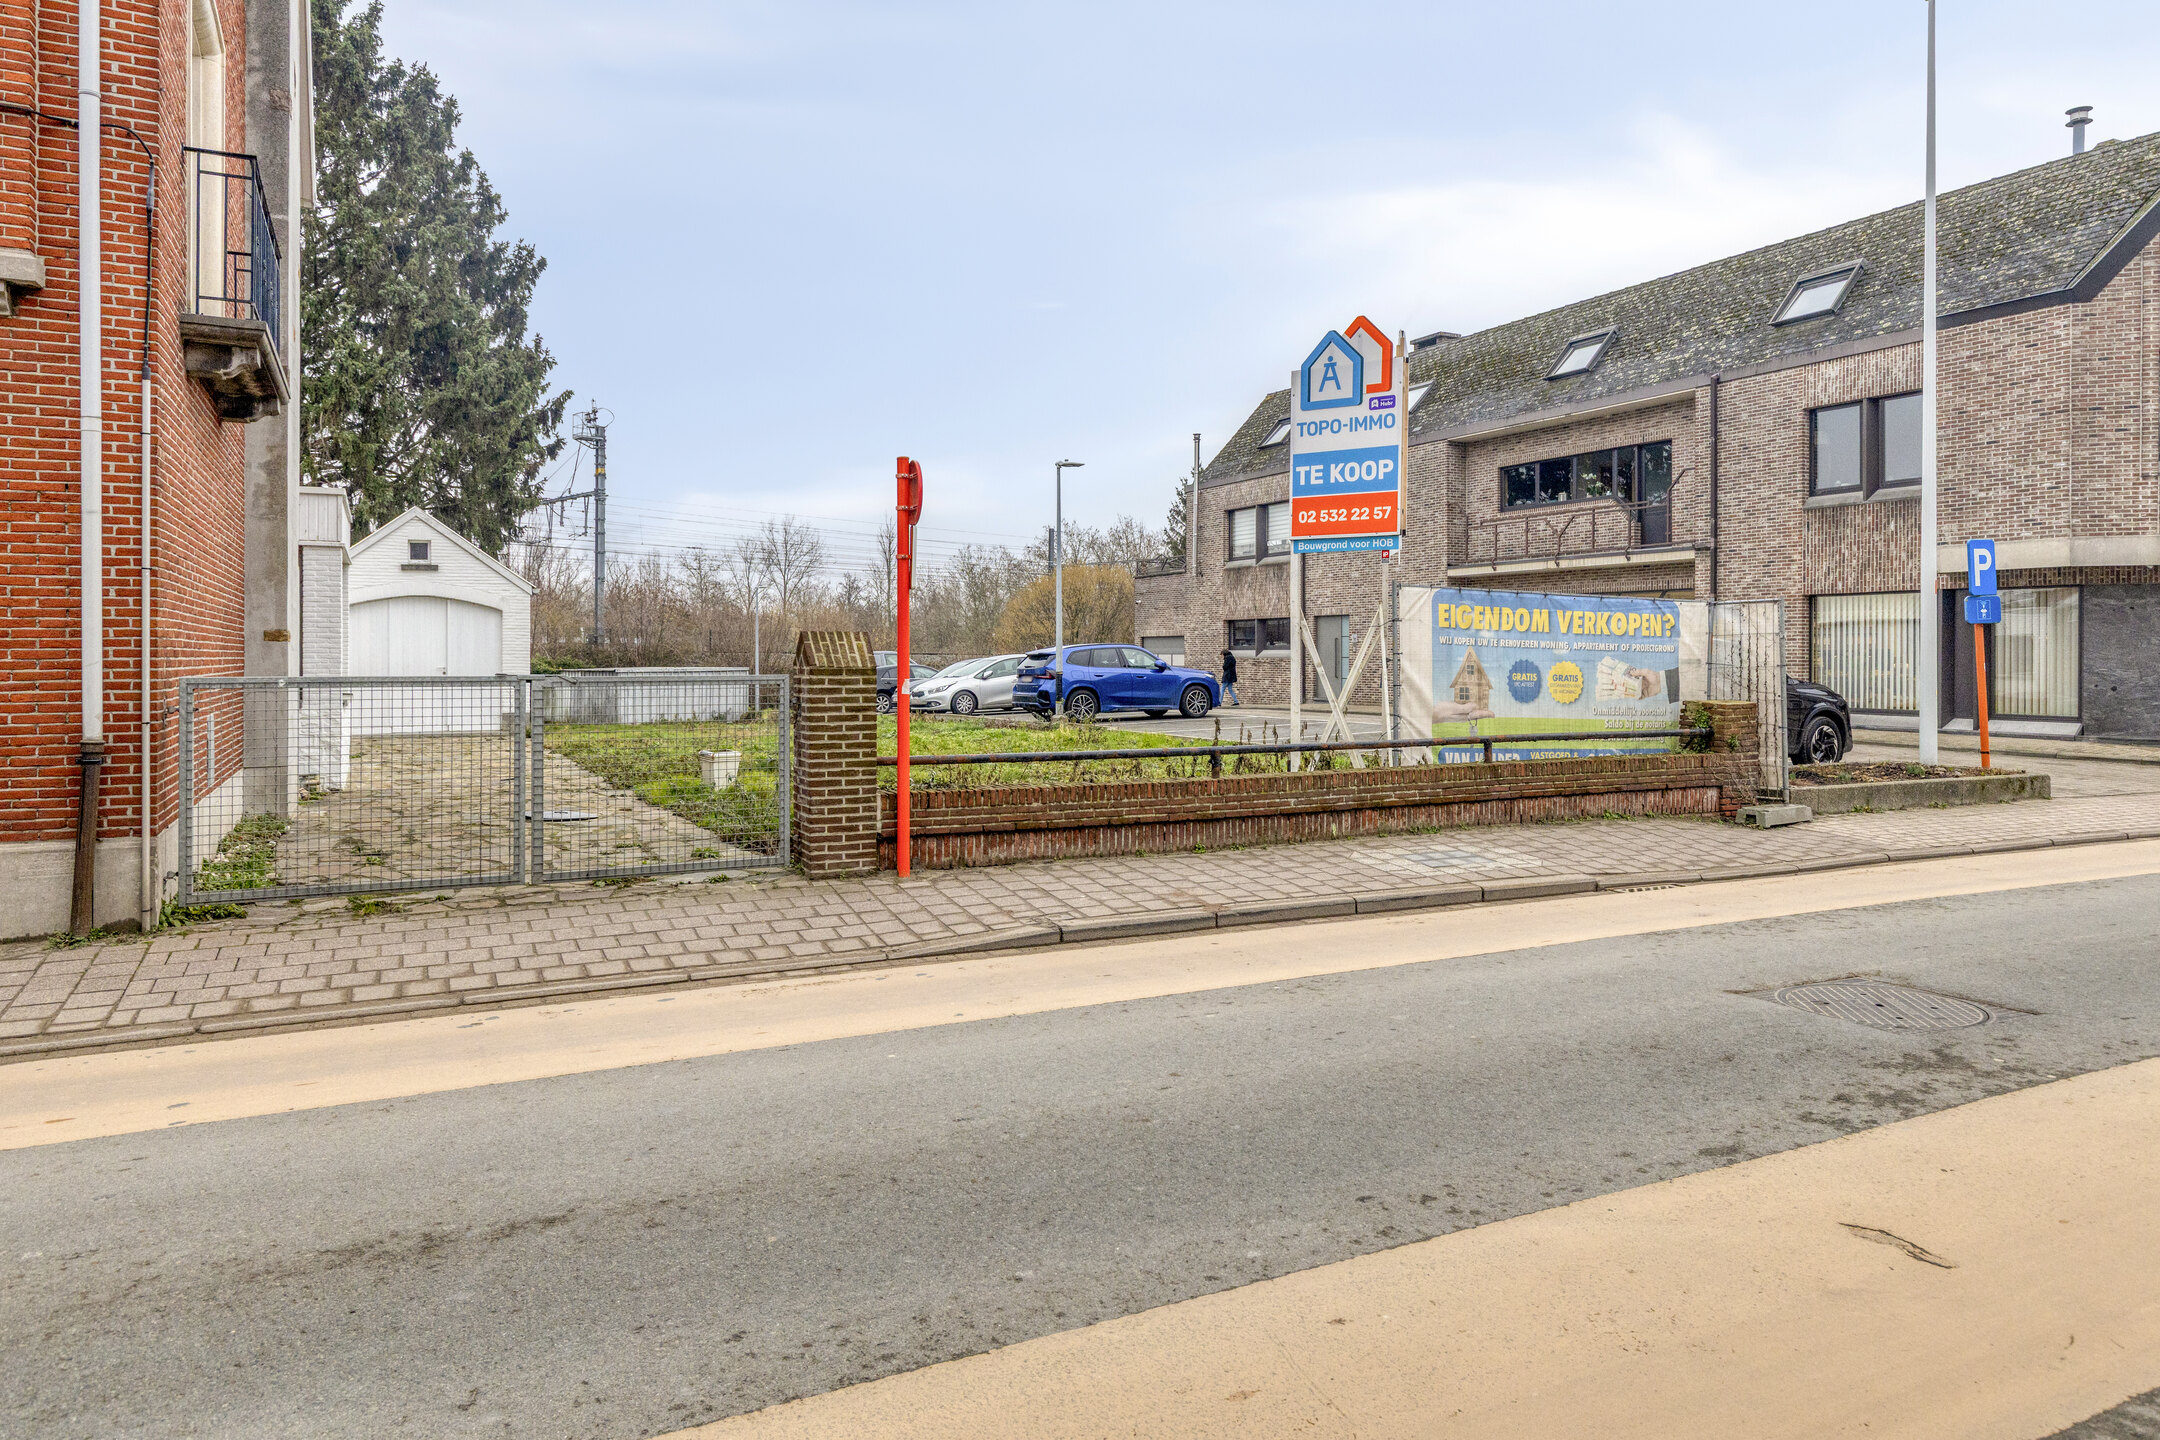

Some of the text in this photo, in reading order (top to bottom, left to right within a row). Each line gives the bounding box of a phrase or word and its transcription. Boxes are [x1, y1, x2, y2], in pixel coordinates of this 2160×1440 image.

[1297, 413, 1396, 437] TOPO-IMMO
[1296, 459, 1394, 485] TE KOOP
[1298, 506, 1392, 523] 02 532 22 57
[1298, 541, 1348, 551] Bouwgrond
[1372, 538, 1394, 548] HOB
[1973, 548, 1992, 587] P
[1438, 603, 1676, 638] EIGENDOM VERKOPEN?
[1440, 636, 1453, 645] WIJ
[1454, 637, 1476, 646] KOPEN
[1478, 638, 1488, 646] UW
[1490, 639, 1498, 647] TE
[1500, 639, 1539, 649] RENOVEREN
[1540, 641, 1571, 651] WONING,
[1573, 642, 1619, 651] APPARTEMENT
[1632, 644, 1675, 653] PROJECTGROND
[1512, 672, 1538, 681] GRATIS
[1552, 674, 1579, 682] GRATIS
[1604, 719, 1666, 730] Saldo bij de notaris
[1445, 752, 1470, 763] VAN
